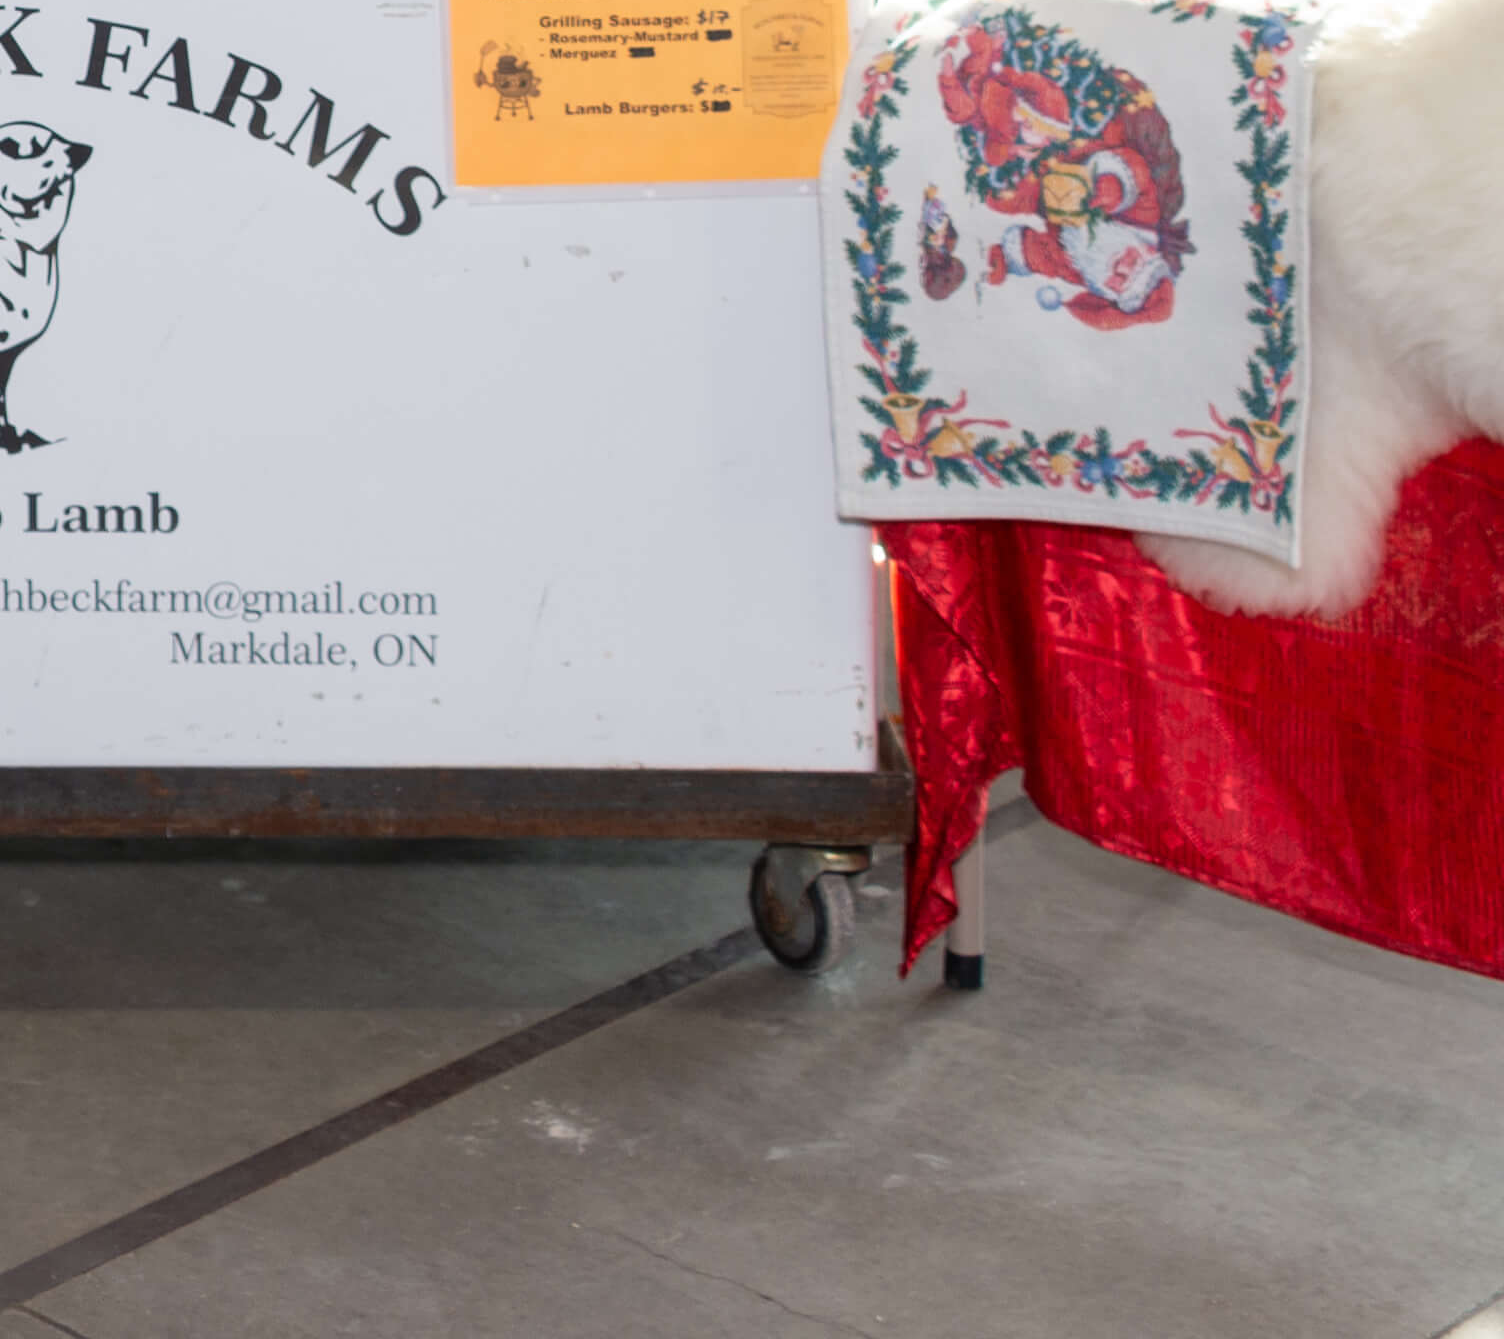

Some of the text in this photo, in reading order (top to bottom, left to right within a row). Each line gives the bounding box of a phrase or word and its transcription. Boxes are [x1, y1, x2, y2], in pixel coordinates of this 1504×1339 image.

[538, 14, 604, 30] Grilling
[609, 13, 690, 29] Sausage:
[548, 30, 700, 45] Rosemary-Mustard
[548, 48, 618, 61] Merguez
[564, 103, 613, 116] Lamb
[75, 17, 449, 237] FARMS
[23, 491, 181, 535] Lamb
[169, 632, 358, 671] Markdale,
[373, 632, 439, 667] ON
